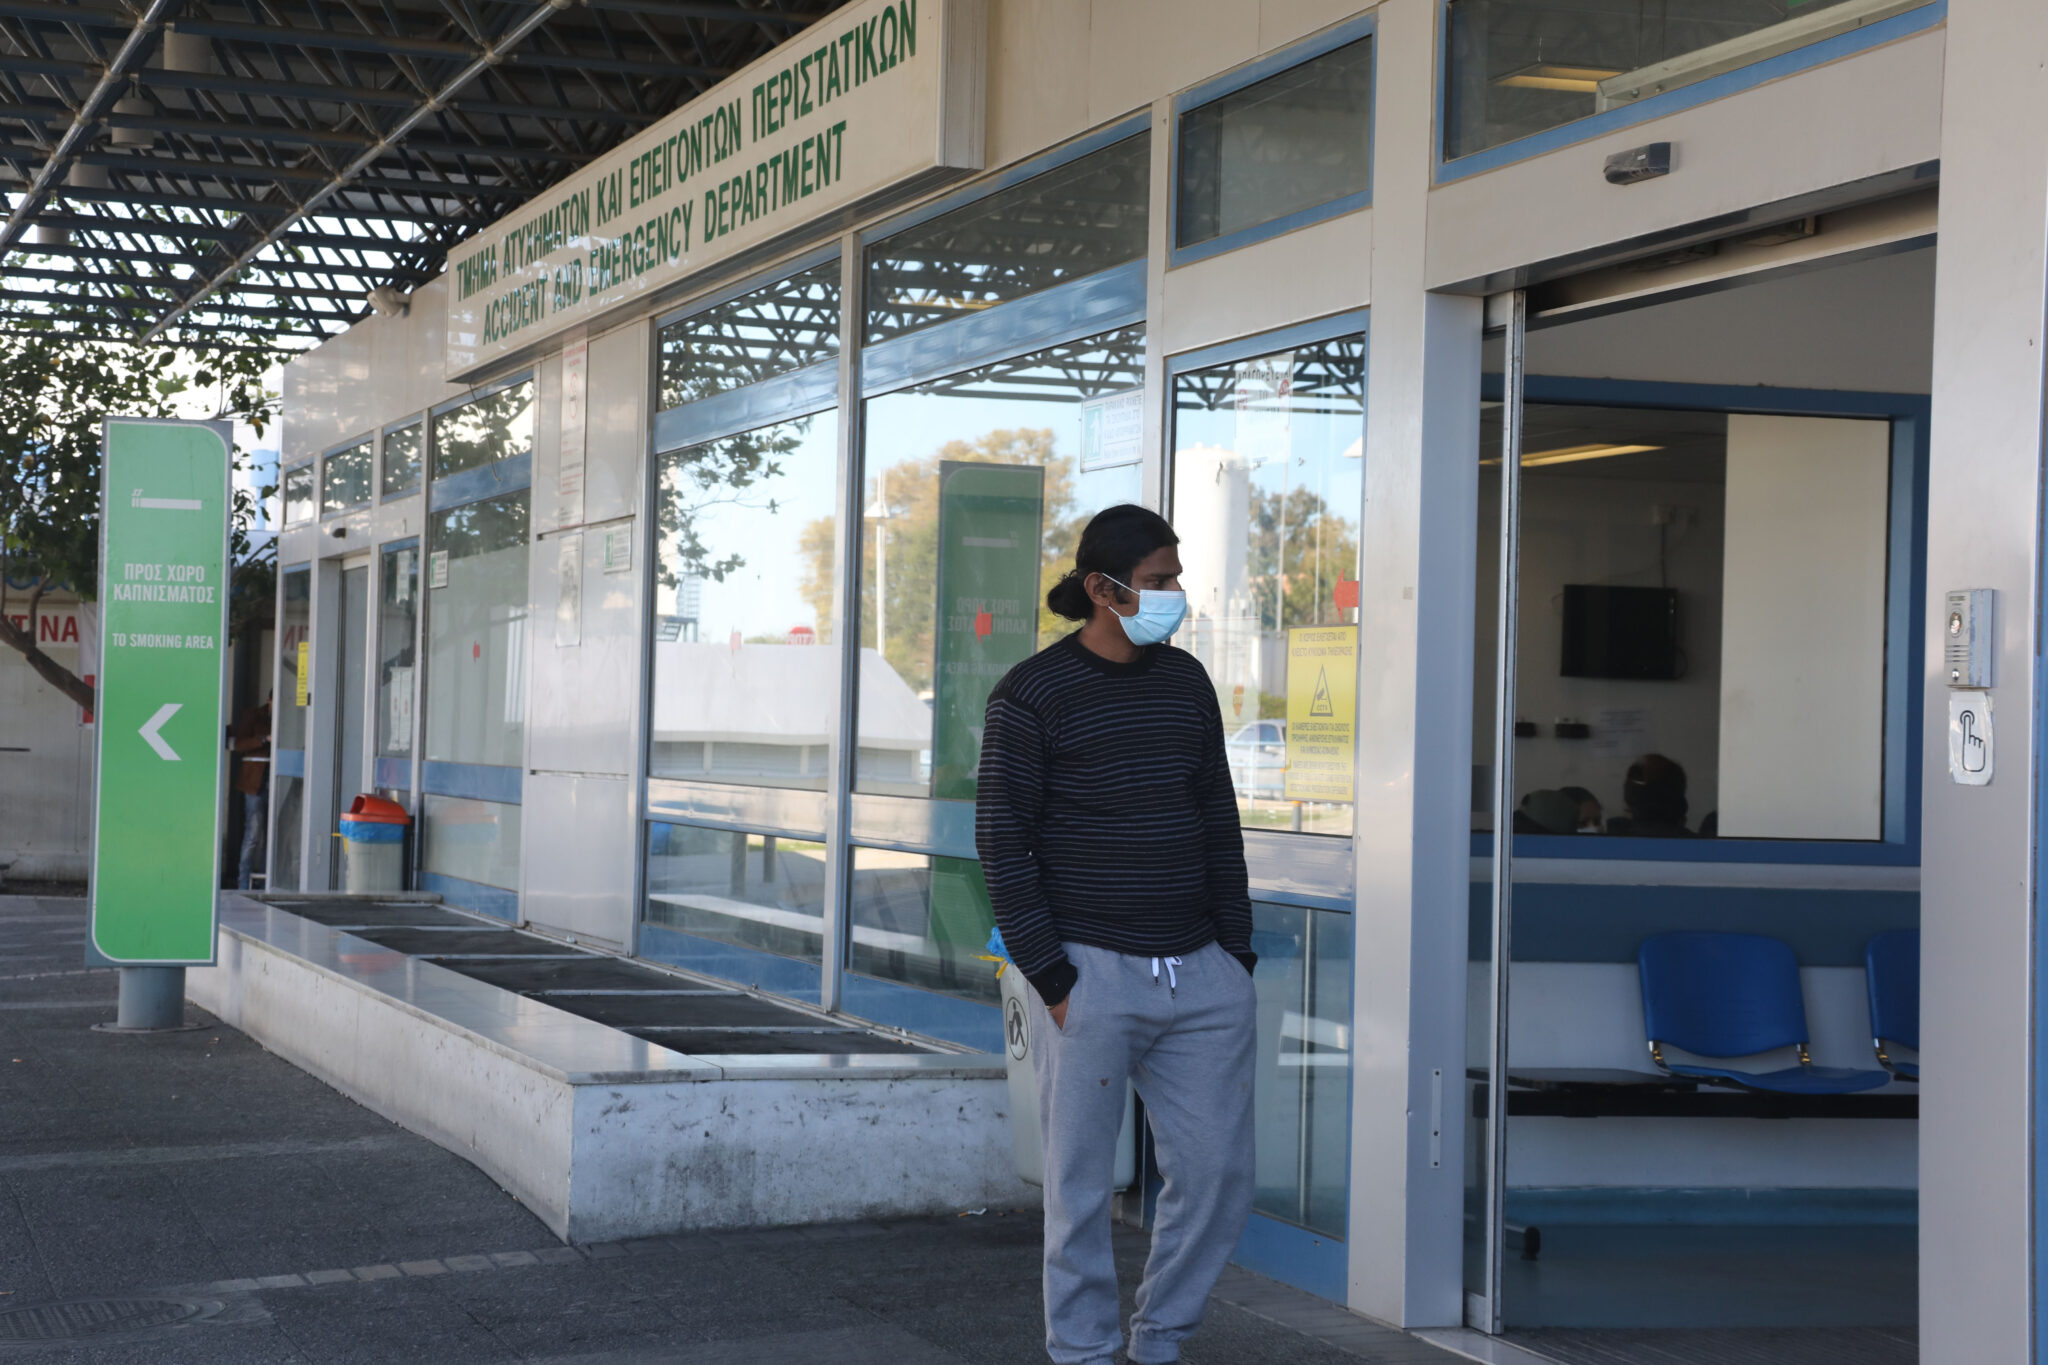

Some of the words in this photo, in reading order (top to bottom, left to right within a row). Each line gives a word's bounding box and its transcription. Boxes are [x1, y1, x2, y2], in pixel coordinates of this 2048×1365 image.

[456, 243, 497, 302] ΤΜΗΜΑ
[502, 187, 590, 279] ΑΤΥΧΗΜΑΤΩΝ
[597, 168, 623, 228] ΚΑΙ
[630, 97, 742, 209] ΕΠΕΙΓΟΝΤΩΝ
[752, 0, 917, 144] ΠΕΡΙΣΤΑΤΙΚΩΝ
[483, 273, 548, 346] ACCIDENT
[552, 257, 583, 314] AND
[589, 198, 694, 297] EMERGENCY
[703, 119, 847, 244] DEPARTMENT
[124, 562, 163, 581] ΠΡΟΣ
[167, 564, 205, 583] ΧΩΡΟ
[113, 583, 215, 604] ΚΑΠΝΙΣΜΑΤΟΣ
[112, 632, 127, 647] TO
[129, 633, 182, 648] SMOKING
[185, 635, 214, 649] AREA
